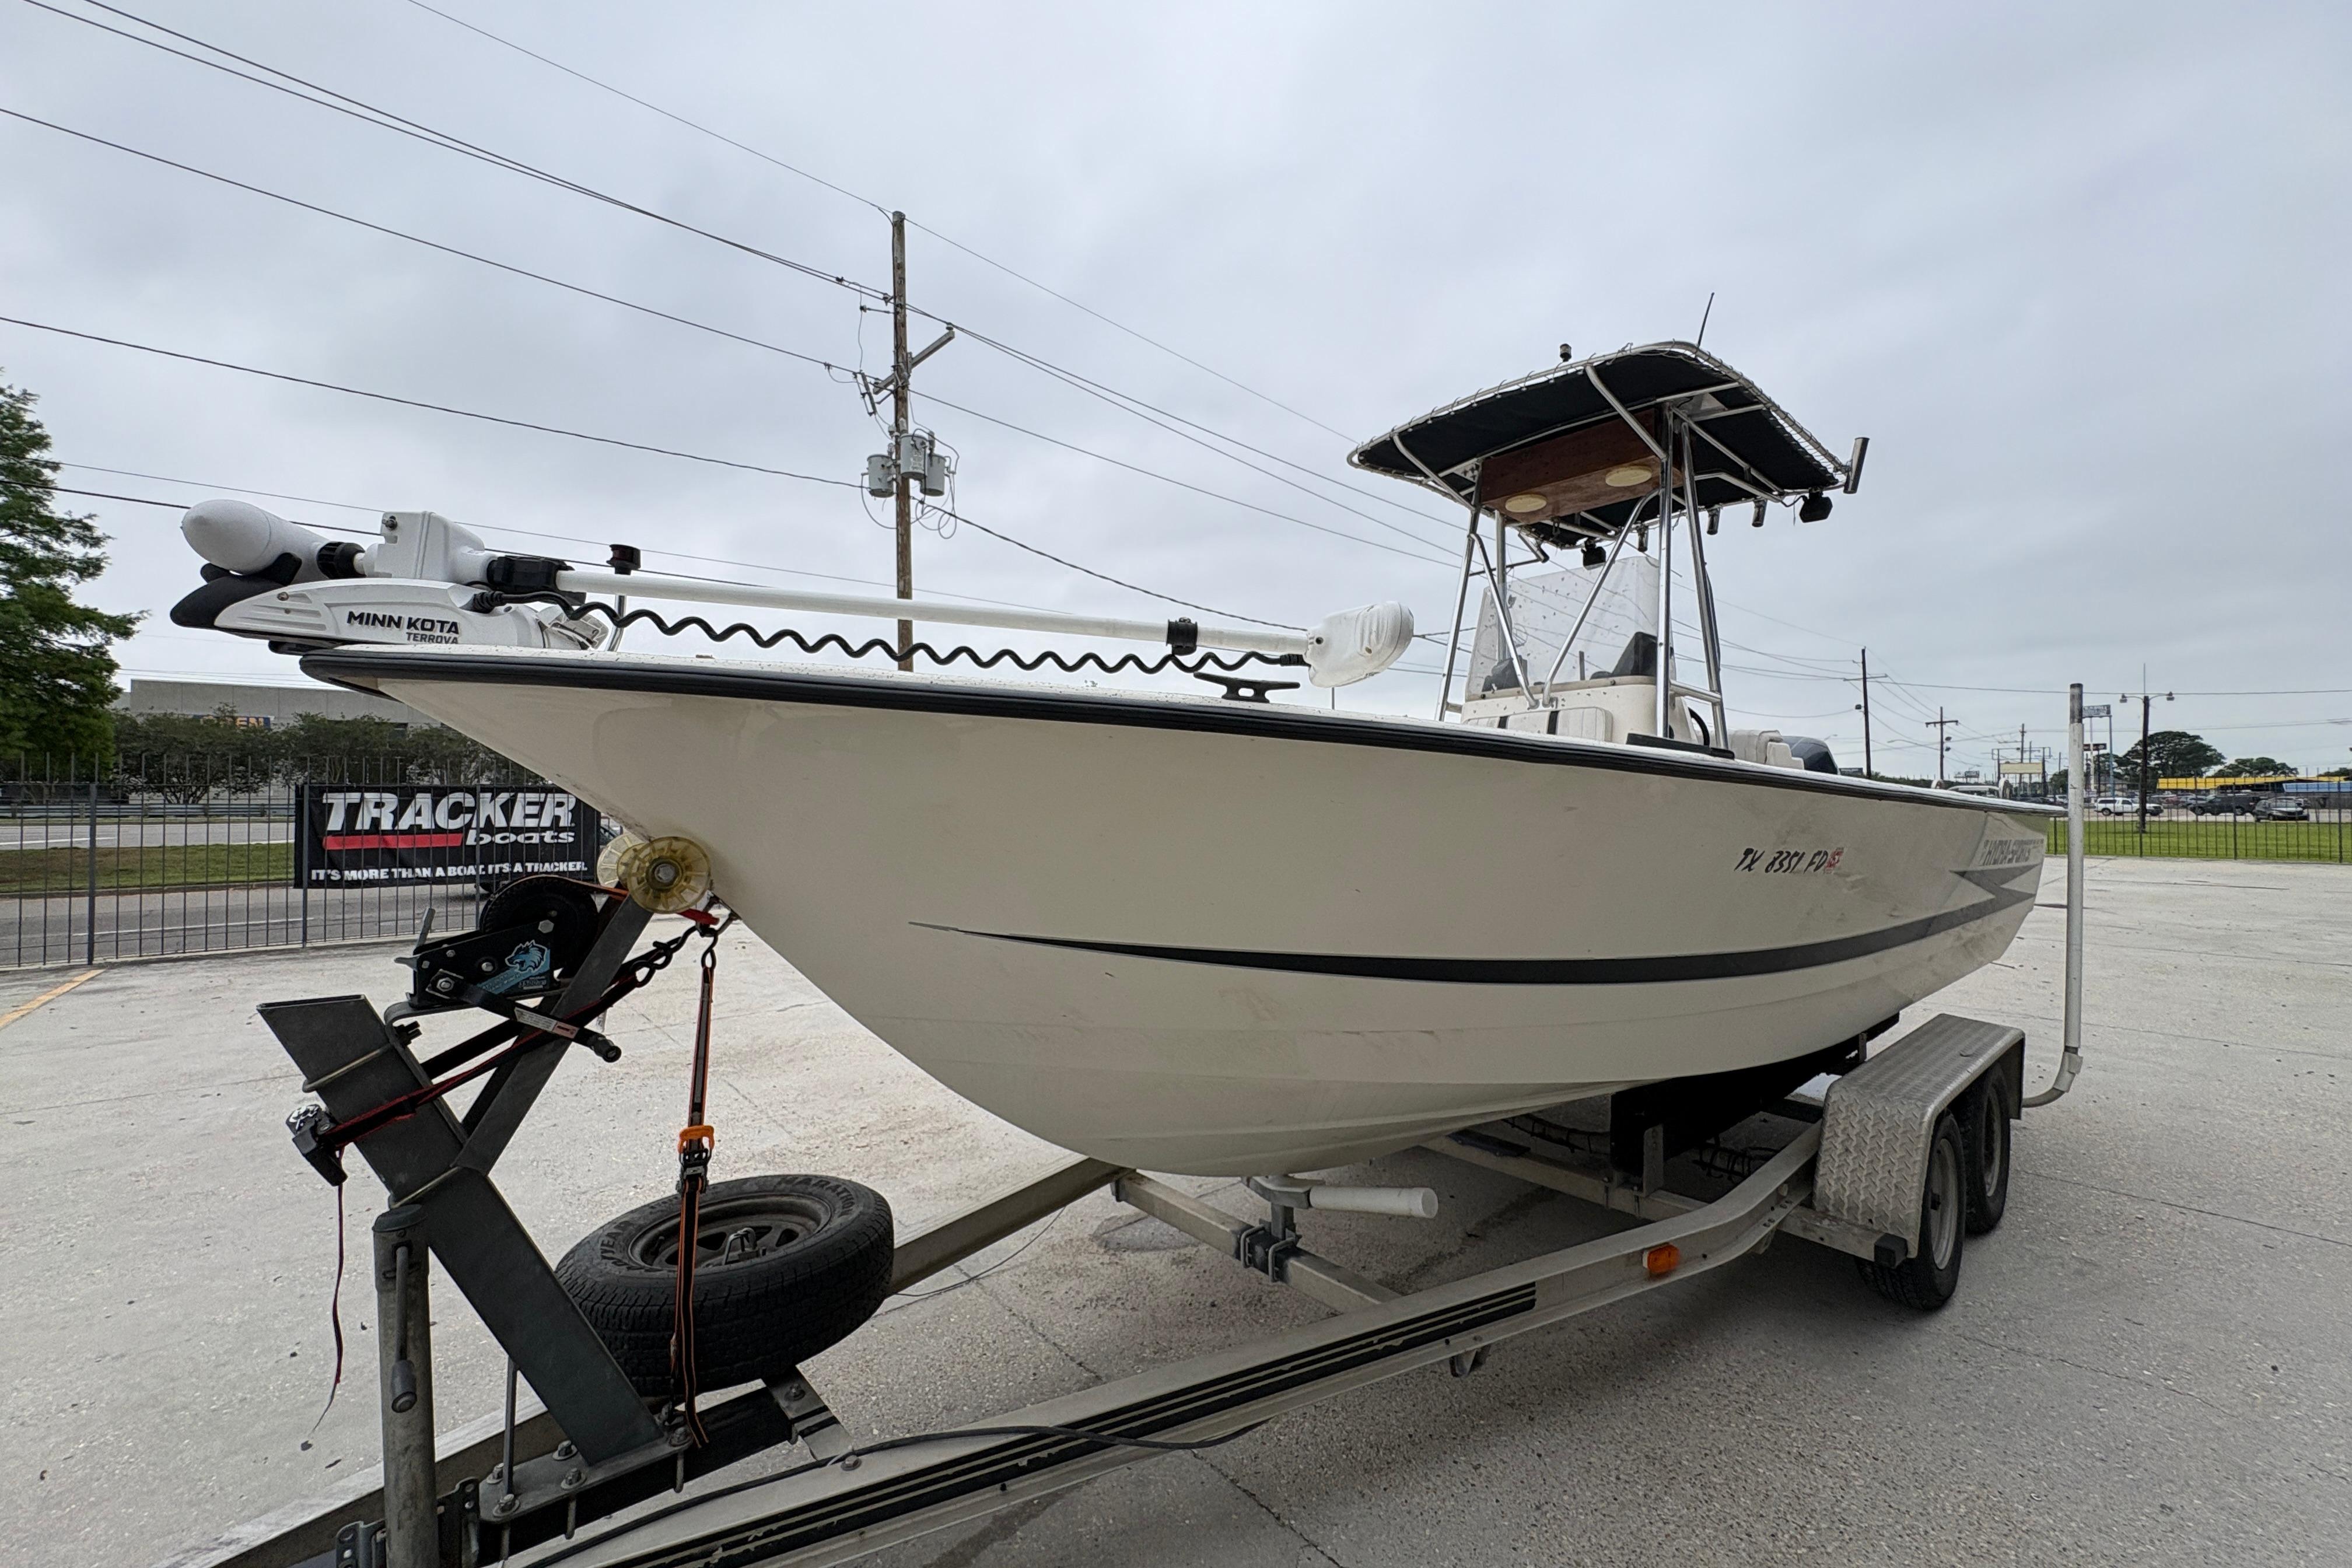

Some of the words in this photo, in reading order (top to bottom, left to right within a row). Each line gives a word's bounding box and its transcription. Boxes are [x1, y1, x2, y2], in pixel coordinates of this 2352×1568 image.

[346, 611, 403, 629] MINN
[406, 617, 460, 635] KOTA
[406, 632, 459, 645] TERROVA
[322, 792, 576, 831] TRACKER
[466, 829, 575, 846] boats
[311, 869, 342, 881] IT'S
[343, 868, 390, 881] MORE
[391, 867, 433, 878] THAN
[435, 866, 446, 877] A
[447, 864, 486, 877] BOAT.
[513, 862, 523, 873] A
[1734, 848, 1766, 872] TX
[1764, 850, 1806, 873] 8351
[1803, 849, 1829, 873] FD
[773, 1176, 856, 1218] MARATHON
